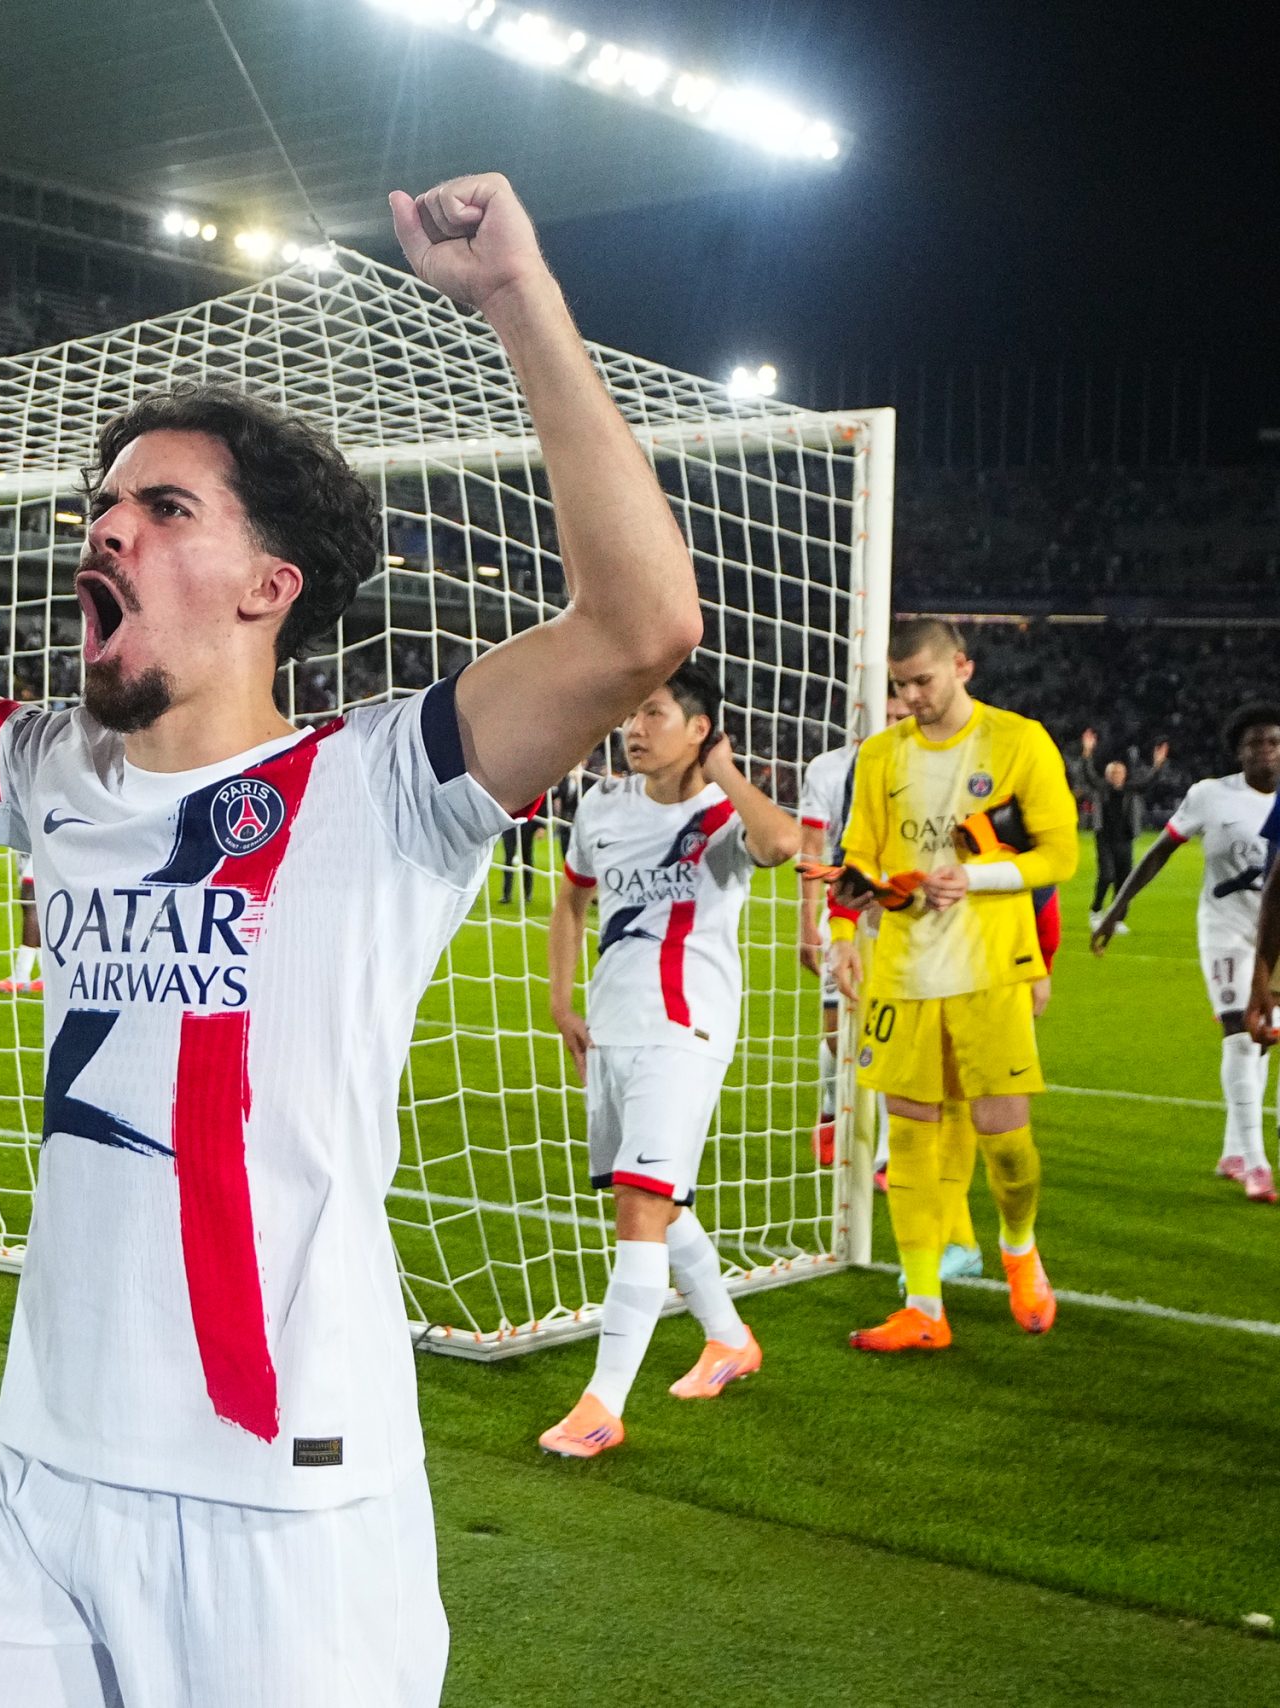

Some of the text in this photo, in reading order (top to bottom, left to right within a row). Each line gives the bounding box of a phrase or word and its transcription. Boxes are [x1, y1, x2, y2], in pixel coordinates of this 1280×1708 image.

[219, 782, 270, 803] PARIS
[901, 812, 976, 843] QATA
[605, 861, 694, 897] QATAR
[45, 888, 249, 967] QATAR
[69, 961, 248, 1007] AIRWAYS
